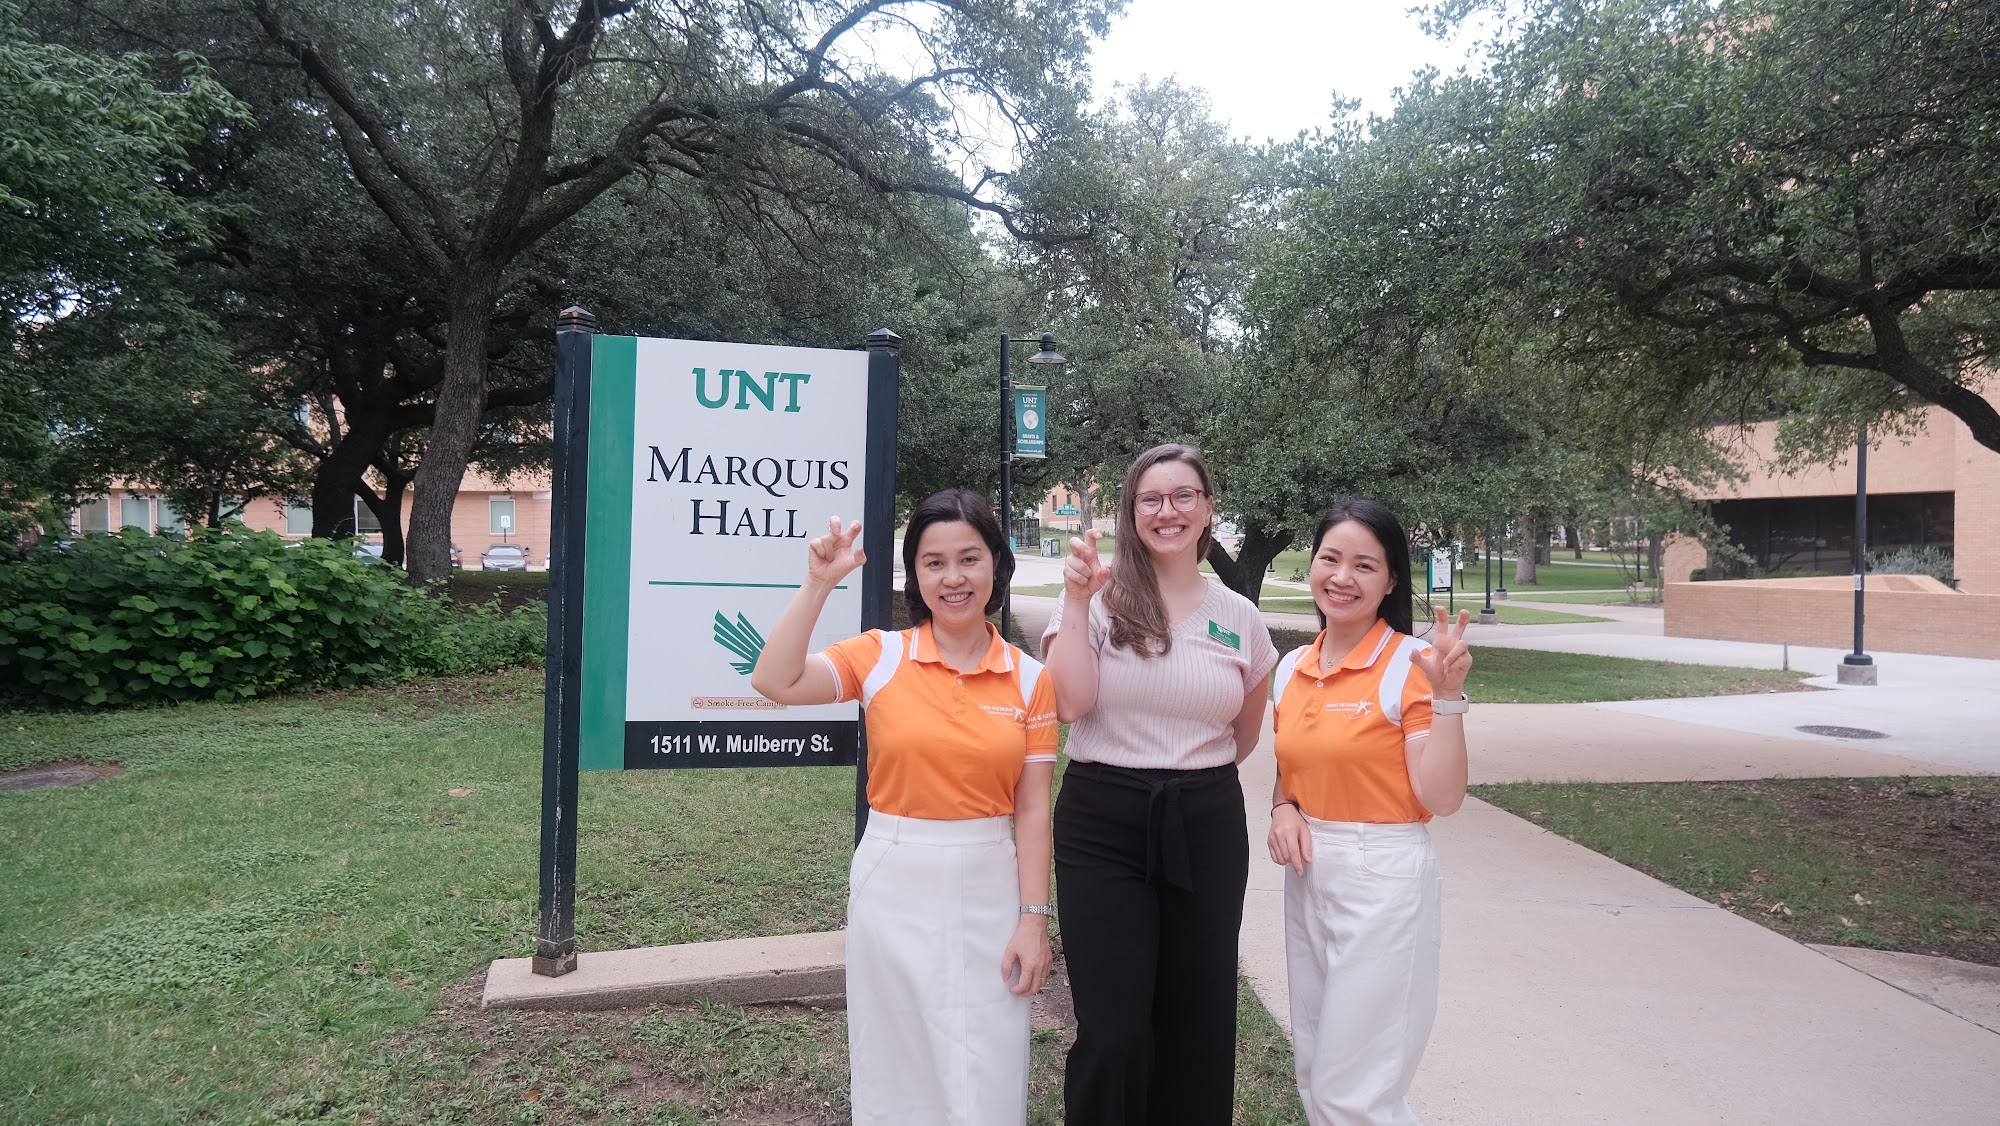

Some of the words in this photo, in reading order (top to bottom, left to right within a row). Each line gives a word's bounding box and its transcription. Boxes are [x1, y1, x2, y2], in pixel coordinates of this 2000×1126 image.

[691, 367, 811, 413] UNT
[1022, 396, 1038, 404] UNT
[646, 445, 849, 498] MARQUIS
[689, 499, 807, 539] HALL
[707, 699, 754, 707] Smoke-Free
[756, 699, 787, 709] Campu
[650, 735, 691, 754] 1511
[698, 735, 720, 753] W.
[726, 735, 805, 756] Mulberry
[810, 734, 834, 752] St.
